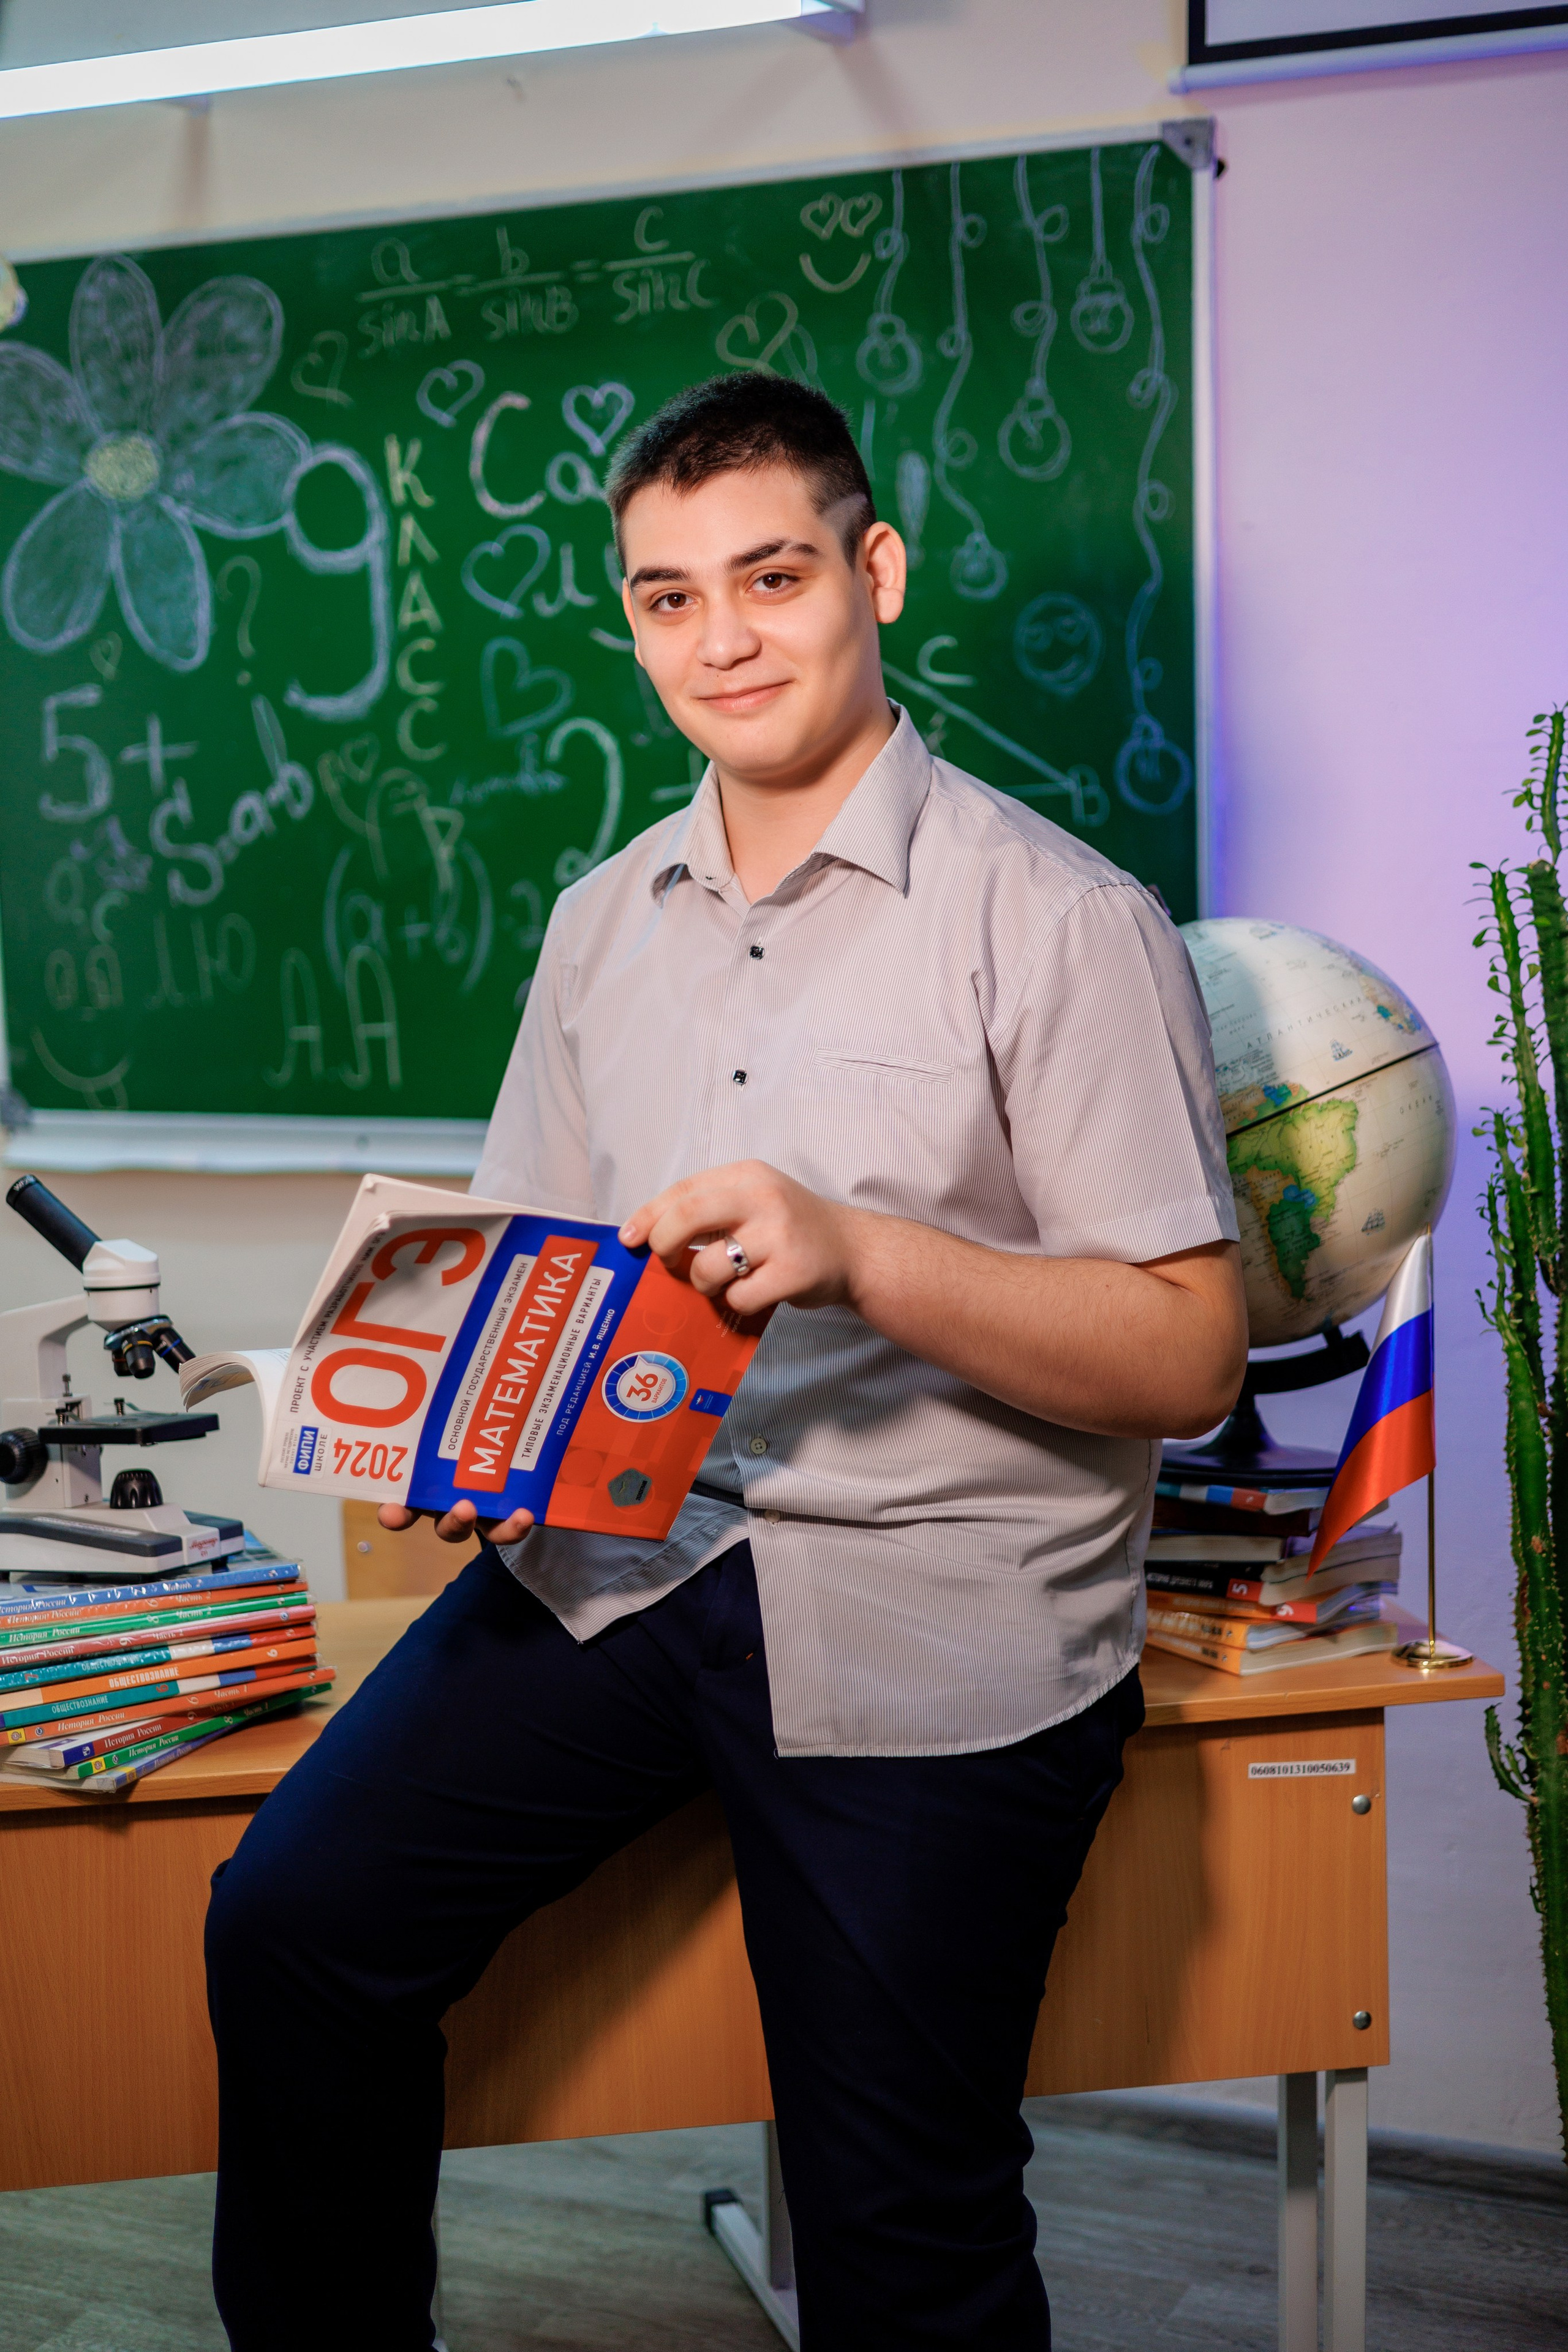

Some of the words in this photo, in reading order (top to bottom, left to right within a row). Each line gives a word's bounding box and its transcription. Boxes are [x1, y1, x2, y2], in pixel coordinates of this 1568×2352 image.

[290, 1376, 306, 1413] ПРОЕКТ
[304, 1320, 328, 1361] УЧАСТИЕМ
[324, 1262, 364, 1319] РАЗРАБОТЧИКОВ
[311, 1227, 486, 1428] ОГЭ
[448, 1399, 471, 1450] ОСНОВНОЙ
[466, 1306, 508, 1396] ГОСУДАРСТВЕННЫЙ
[503, 1262, 528, 1303] ЭКЗАМЕН
[469, 1253, 582, 1475] МАТЕМАТИКА
[521, 1416, 544, 1458] ТИПОВЫЕ
[538, 1328, 581, 1414] ЭКЗАМЕНАЦИОННЫЕ
[576, 1278, 601, 1324] ВАРИАНТЫ
[556, 1417, 570, 1436] ПОД
[565, 1361, 593, 1414] РЕДАКЦИЕЙ
[596, 1308, 615, 1341] ЯЩЕНКО
[626, 1373, 658, 1402] 36
[651, 1378, 668, 1404] ВАРИАНТОВ
[297, 1430, 315, 1471] ФИПИ
[314, 1433, 328, 1471] ШКОЛЕ
[333, 1438, 409, 1482] 2024
[9, 1631, 48, 1643] История
[52, 1627, 81, 1637] России
[2, 1652, 40, 1664] История
[43, 1646, 75, 1658] России
[81, 1654, 140, 1671] ОБЩЕСТВОЗНАНИЕ
[108, 1667, 179, 1688] ОБЩЕСТВОЗНАНИЕ
[51, 1695, 108, 1713] ОБЩЕСТВОЗНАНИЕ
[58, 1718, 94, 1732] История
[98, 1711, 125, 1723] России
[215, 1688, 240, 1698] Часть
[104, 1733, 135, 1749] История
[137, 1724, 162, 1738] России
[129, 1743, 156, 1757] История
[159, 1735, 179, 1747] России
